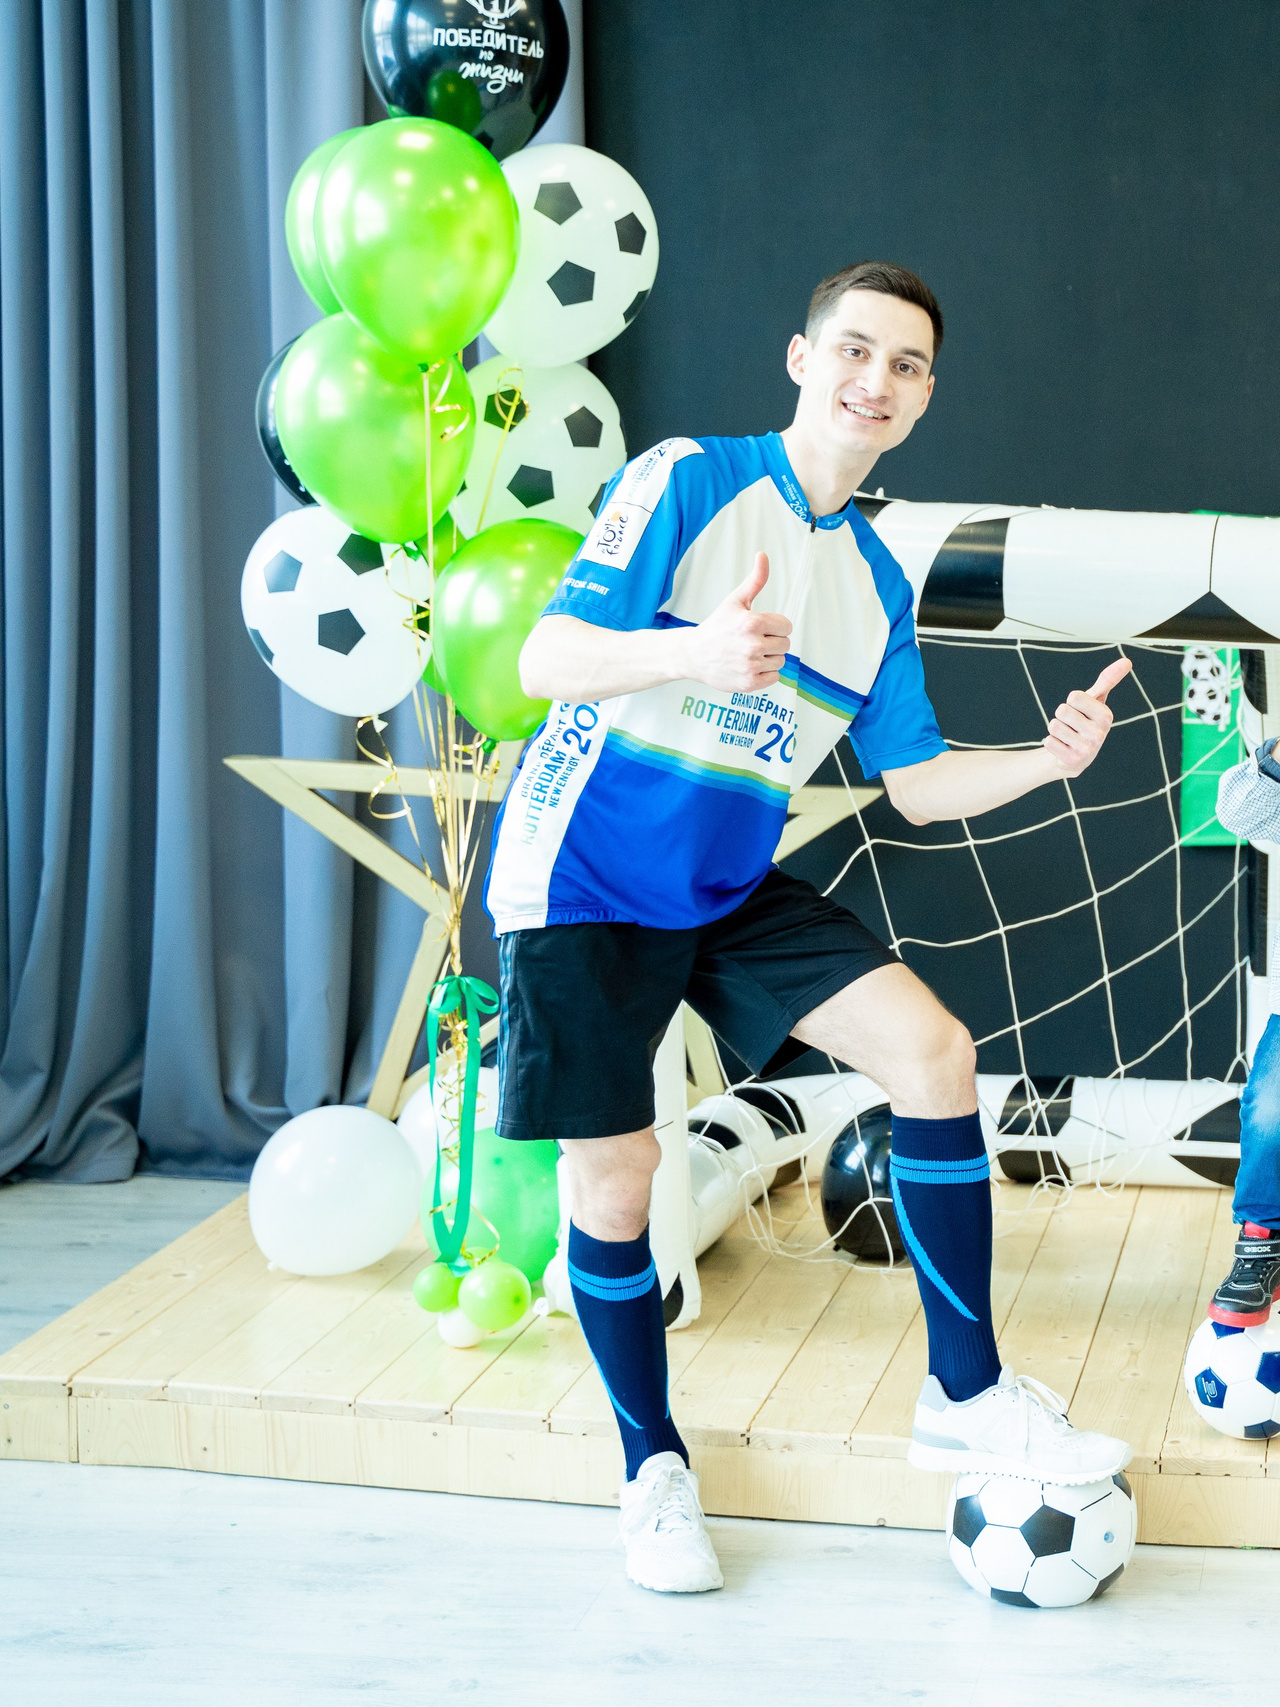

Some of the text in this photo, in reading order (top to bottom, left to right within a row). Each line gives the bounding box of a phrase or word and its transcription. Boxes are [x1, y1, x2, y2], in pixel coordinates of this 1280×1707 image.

[432, 27, 545, 59] ПОБЕДИТЕЛЬ
[478, 48, 495, 61] по
[457, 61, 524, 94] жизни
[789, 500, 808, 521] 2010
[586, 581, 610, 596] SHIRT
[681, 695, 762, 735] ROTTERDAM
[731, 692, 795, 724] GRAND DÉPART
[719, 732, 755, 749] NEW ENERGY
[520, 701, 600, 846] ROTTERDAM 20
[548, 756, 580, 809] NEW ENERGY
